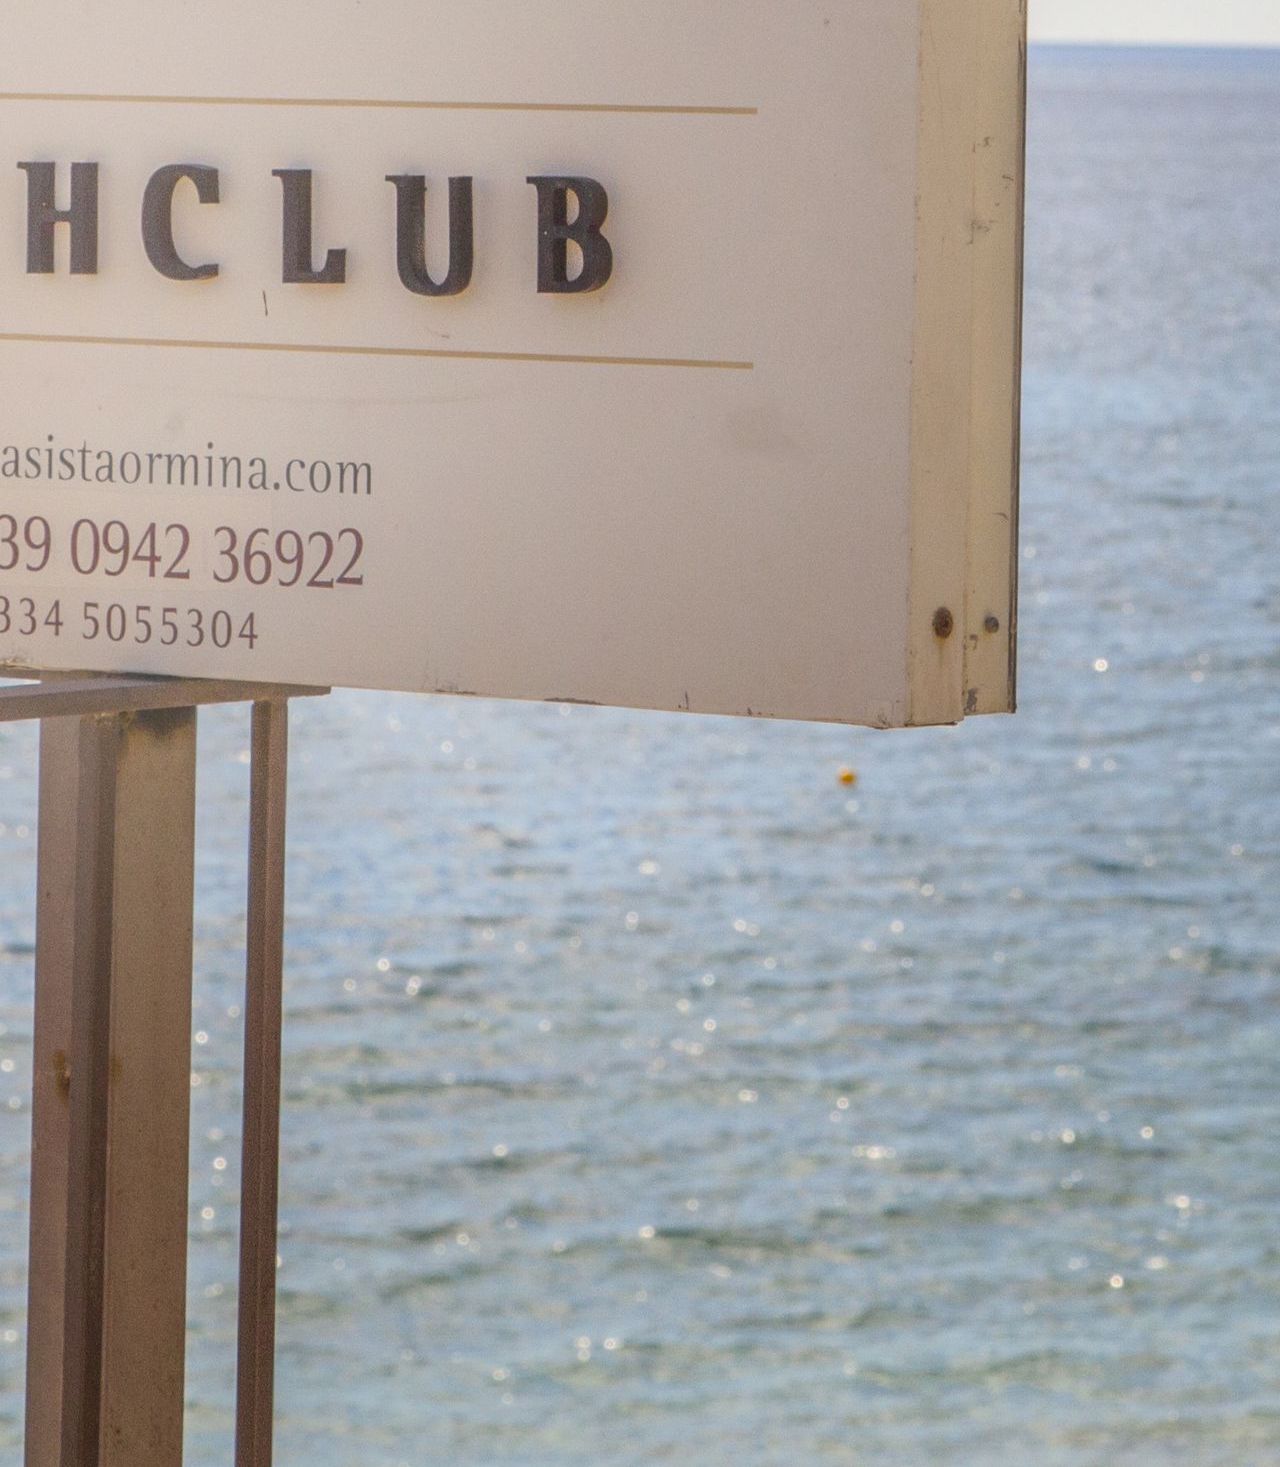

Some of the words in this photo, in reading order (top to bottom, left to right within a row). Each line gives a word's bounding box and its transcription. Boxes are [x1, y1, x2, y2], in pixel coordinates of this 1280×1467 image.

[70, 519, 193, 581] 0942
[211, 527, 365, 589] 36922
[80, 599, 260, 651] 5055304
